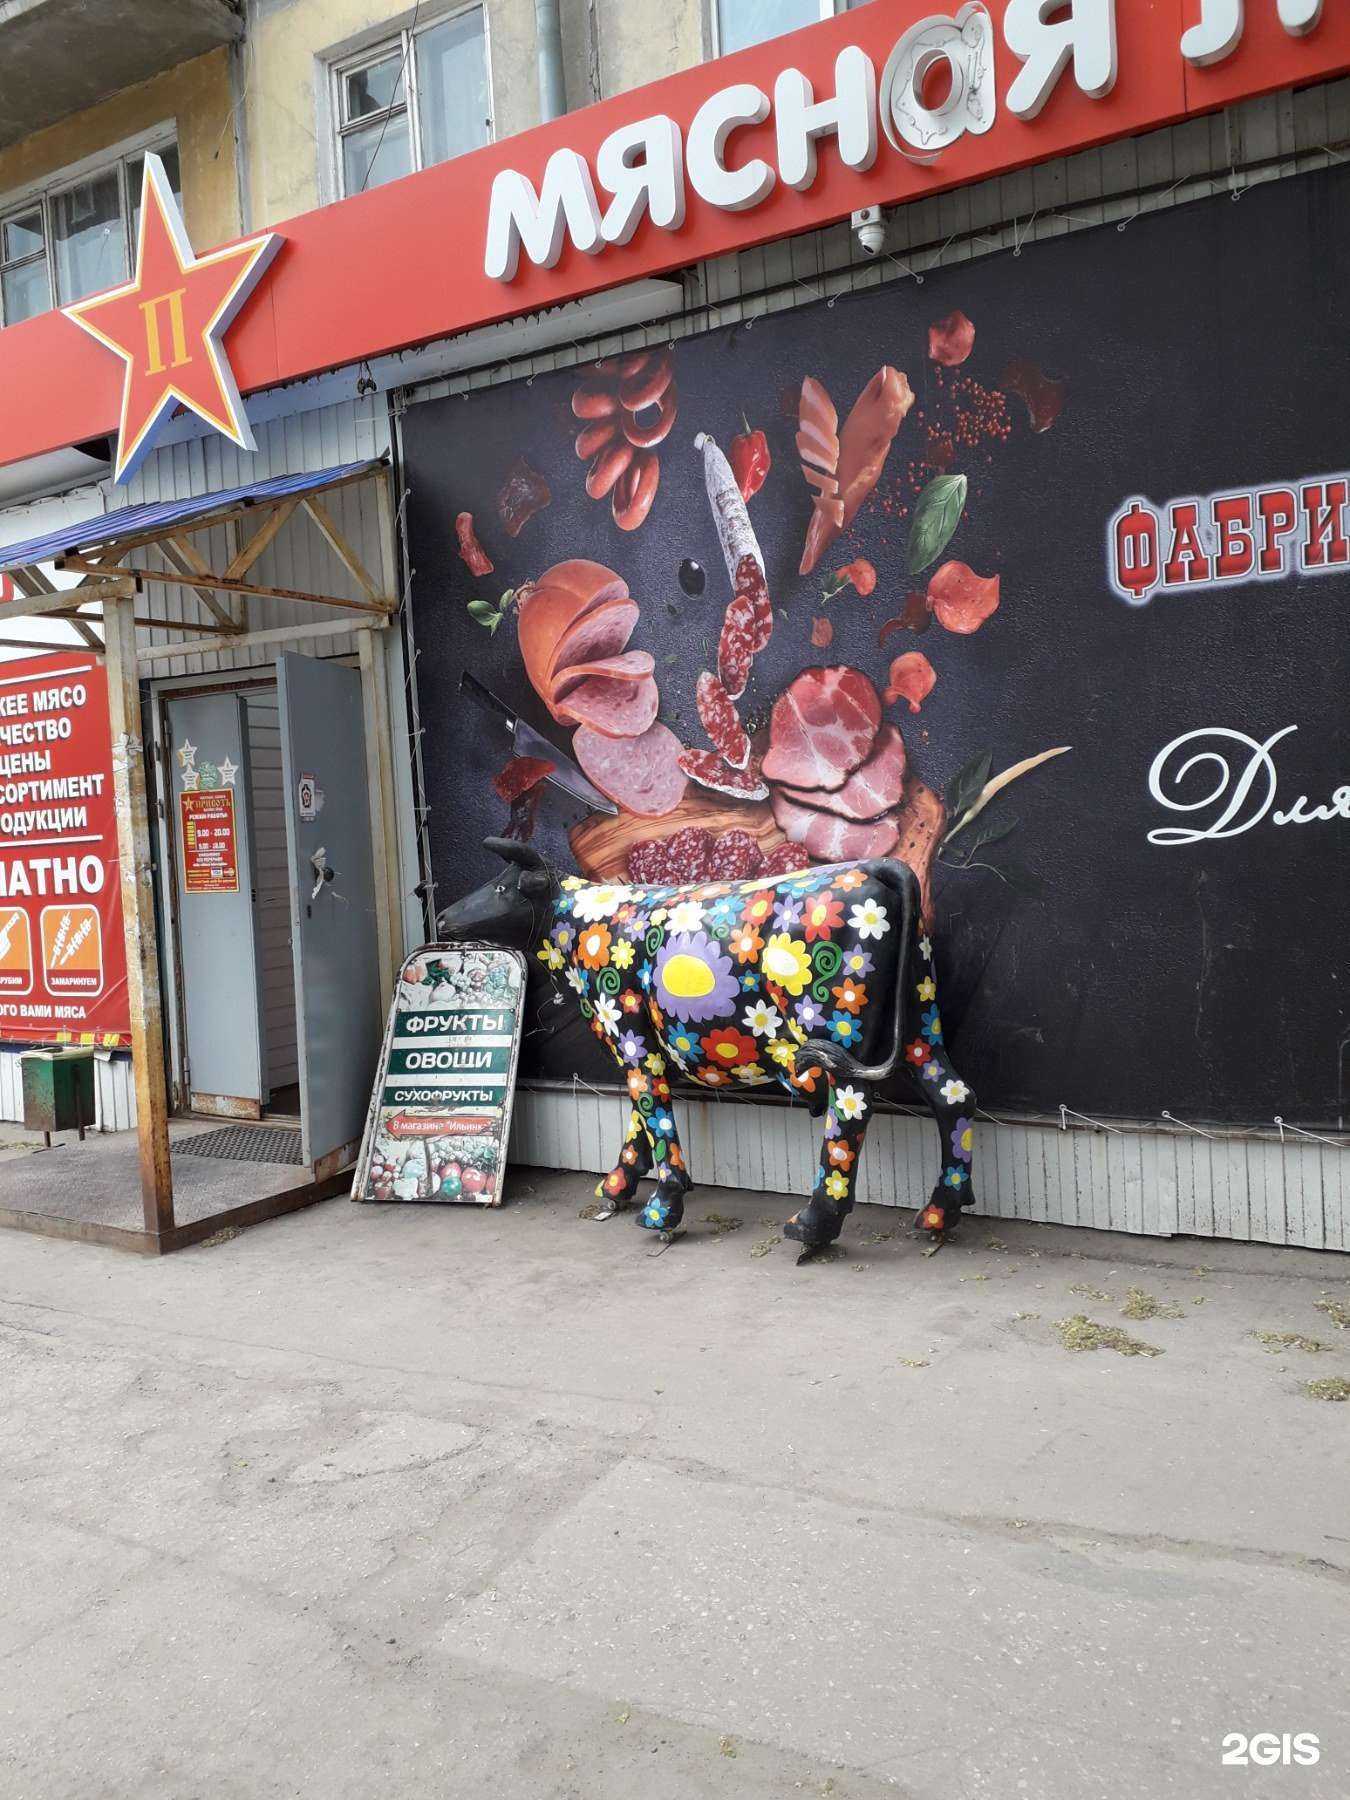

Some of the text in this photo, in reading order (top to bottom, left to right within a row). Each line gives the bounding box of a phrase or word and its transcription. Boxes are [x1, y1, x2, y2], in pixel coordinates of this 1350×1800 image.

[1114, 479, 1350, 600] ФАБРИ
[32, 684, 87, 712] МЯСО
[0, 717, 72, 745] ЧЕСТВО
[0, 749, 51, 778] ЦЕНЫ
[0, 806, 88, 836] ОДУКЦИИ
[20, 1004, 52, 1018] ВАМИ
[54, 1005, 87, 1019] МЯСА
[406, 1014, 504, 1033] ФРУКТЫ
[394, 1090, 493, 1102] СУХОФРУКТЫ
